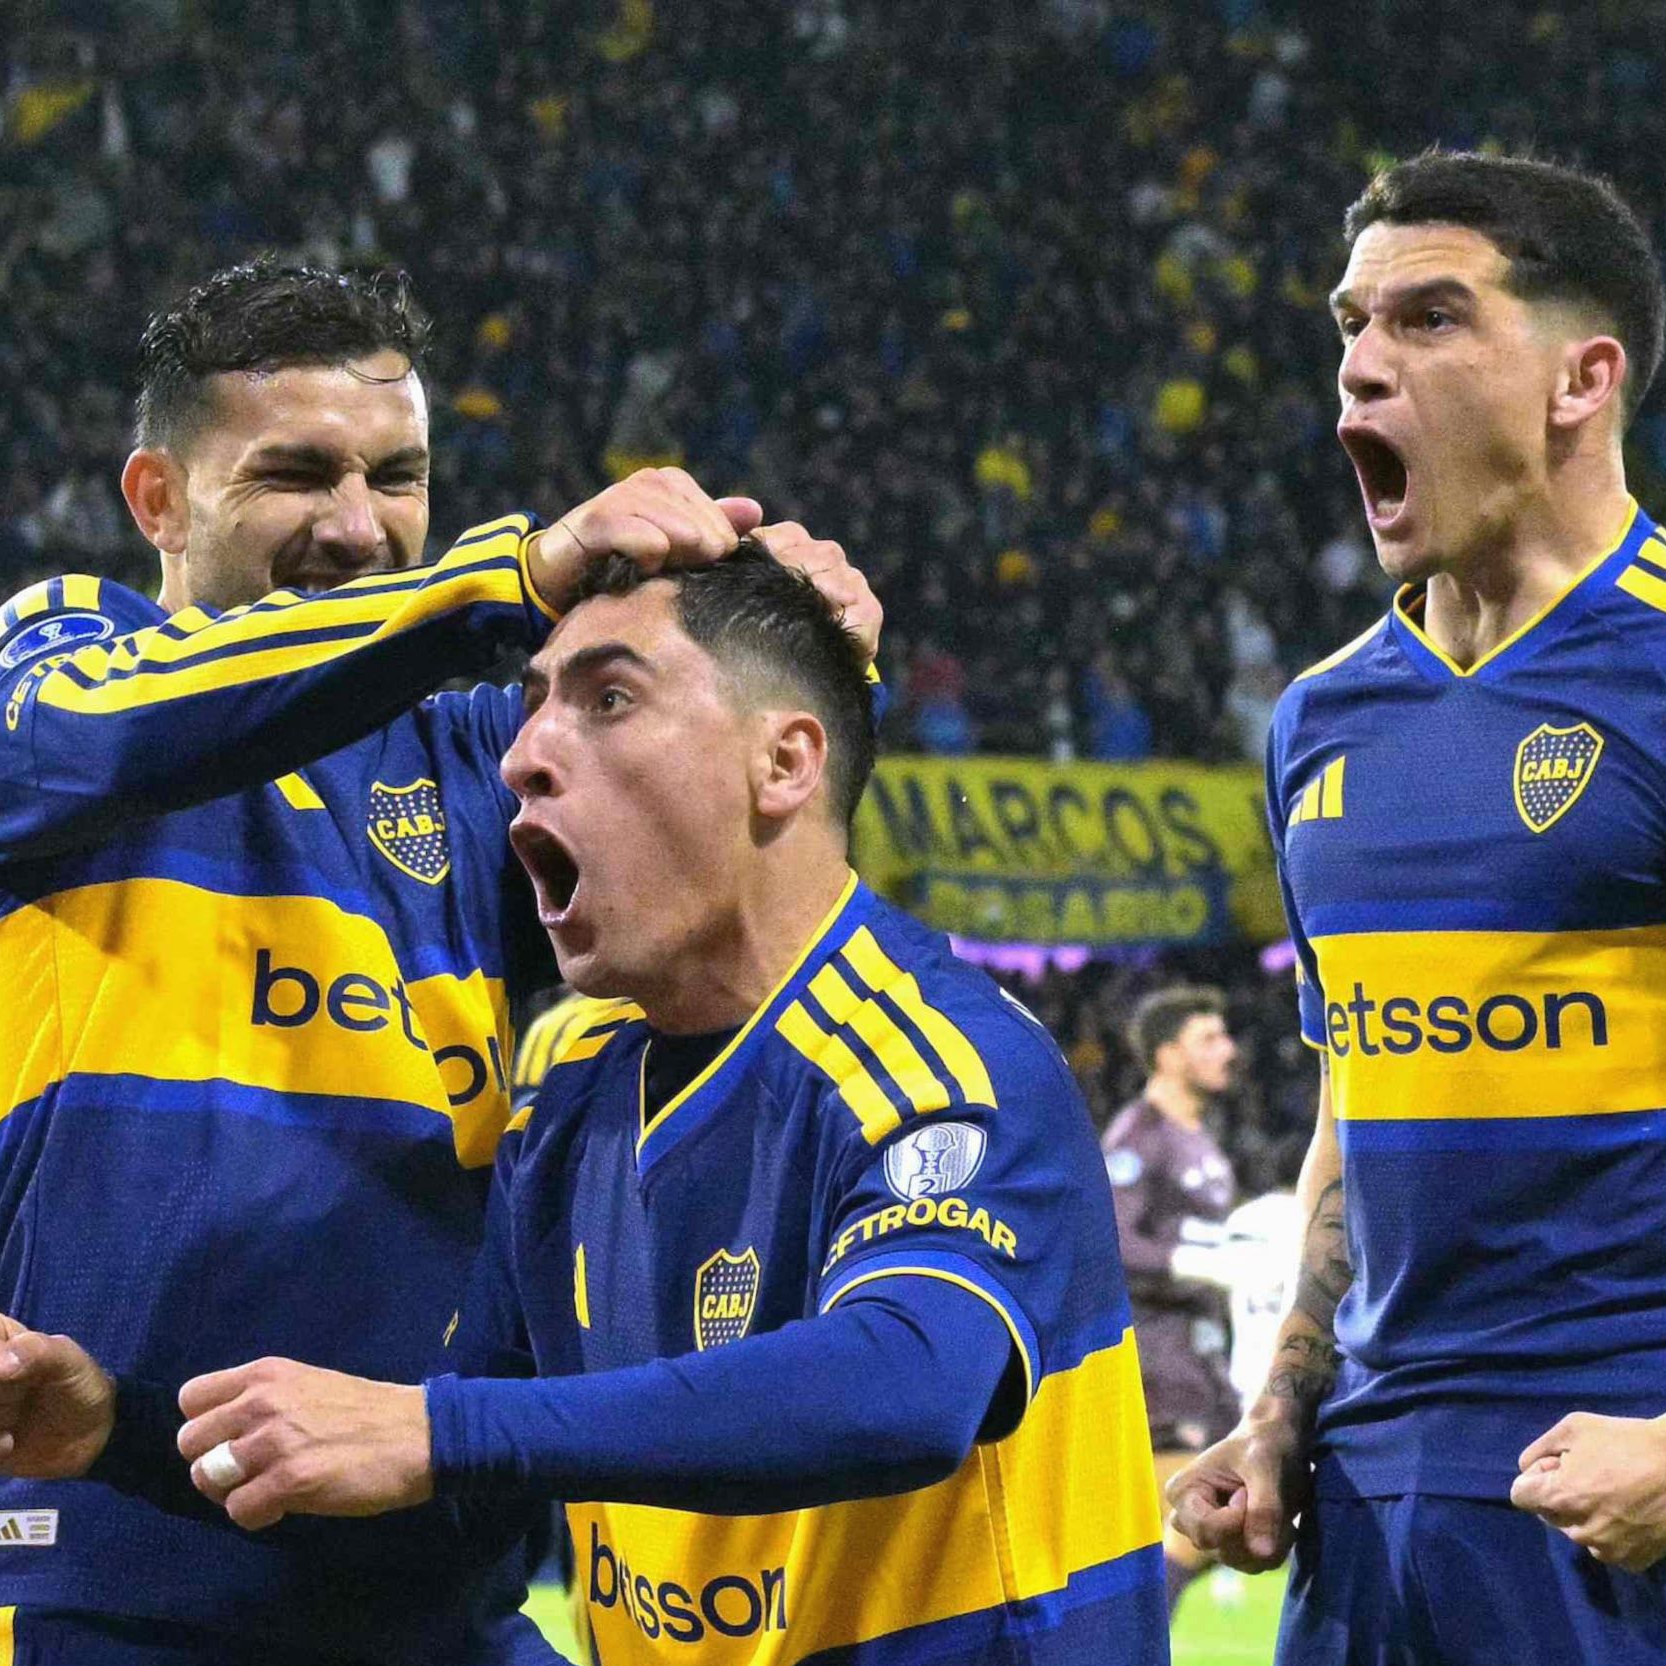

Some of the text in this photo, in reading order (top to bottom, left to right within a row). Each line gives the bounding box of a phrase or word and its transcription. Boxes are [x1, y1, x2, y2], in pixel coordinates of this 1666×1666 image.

[1522, 757, 1585, 782] CABJ
[376, 812, 445, 840] CABJ
[919, 1178, 936, 1196] 2
[702, 1292, 751, 1319] CABJ
